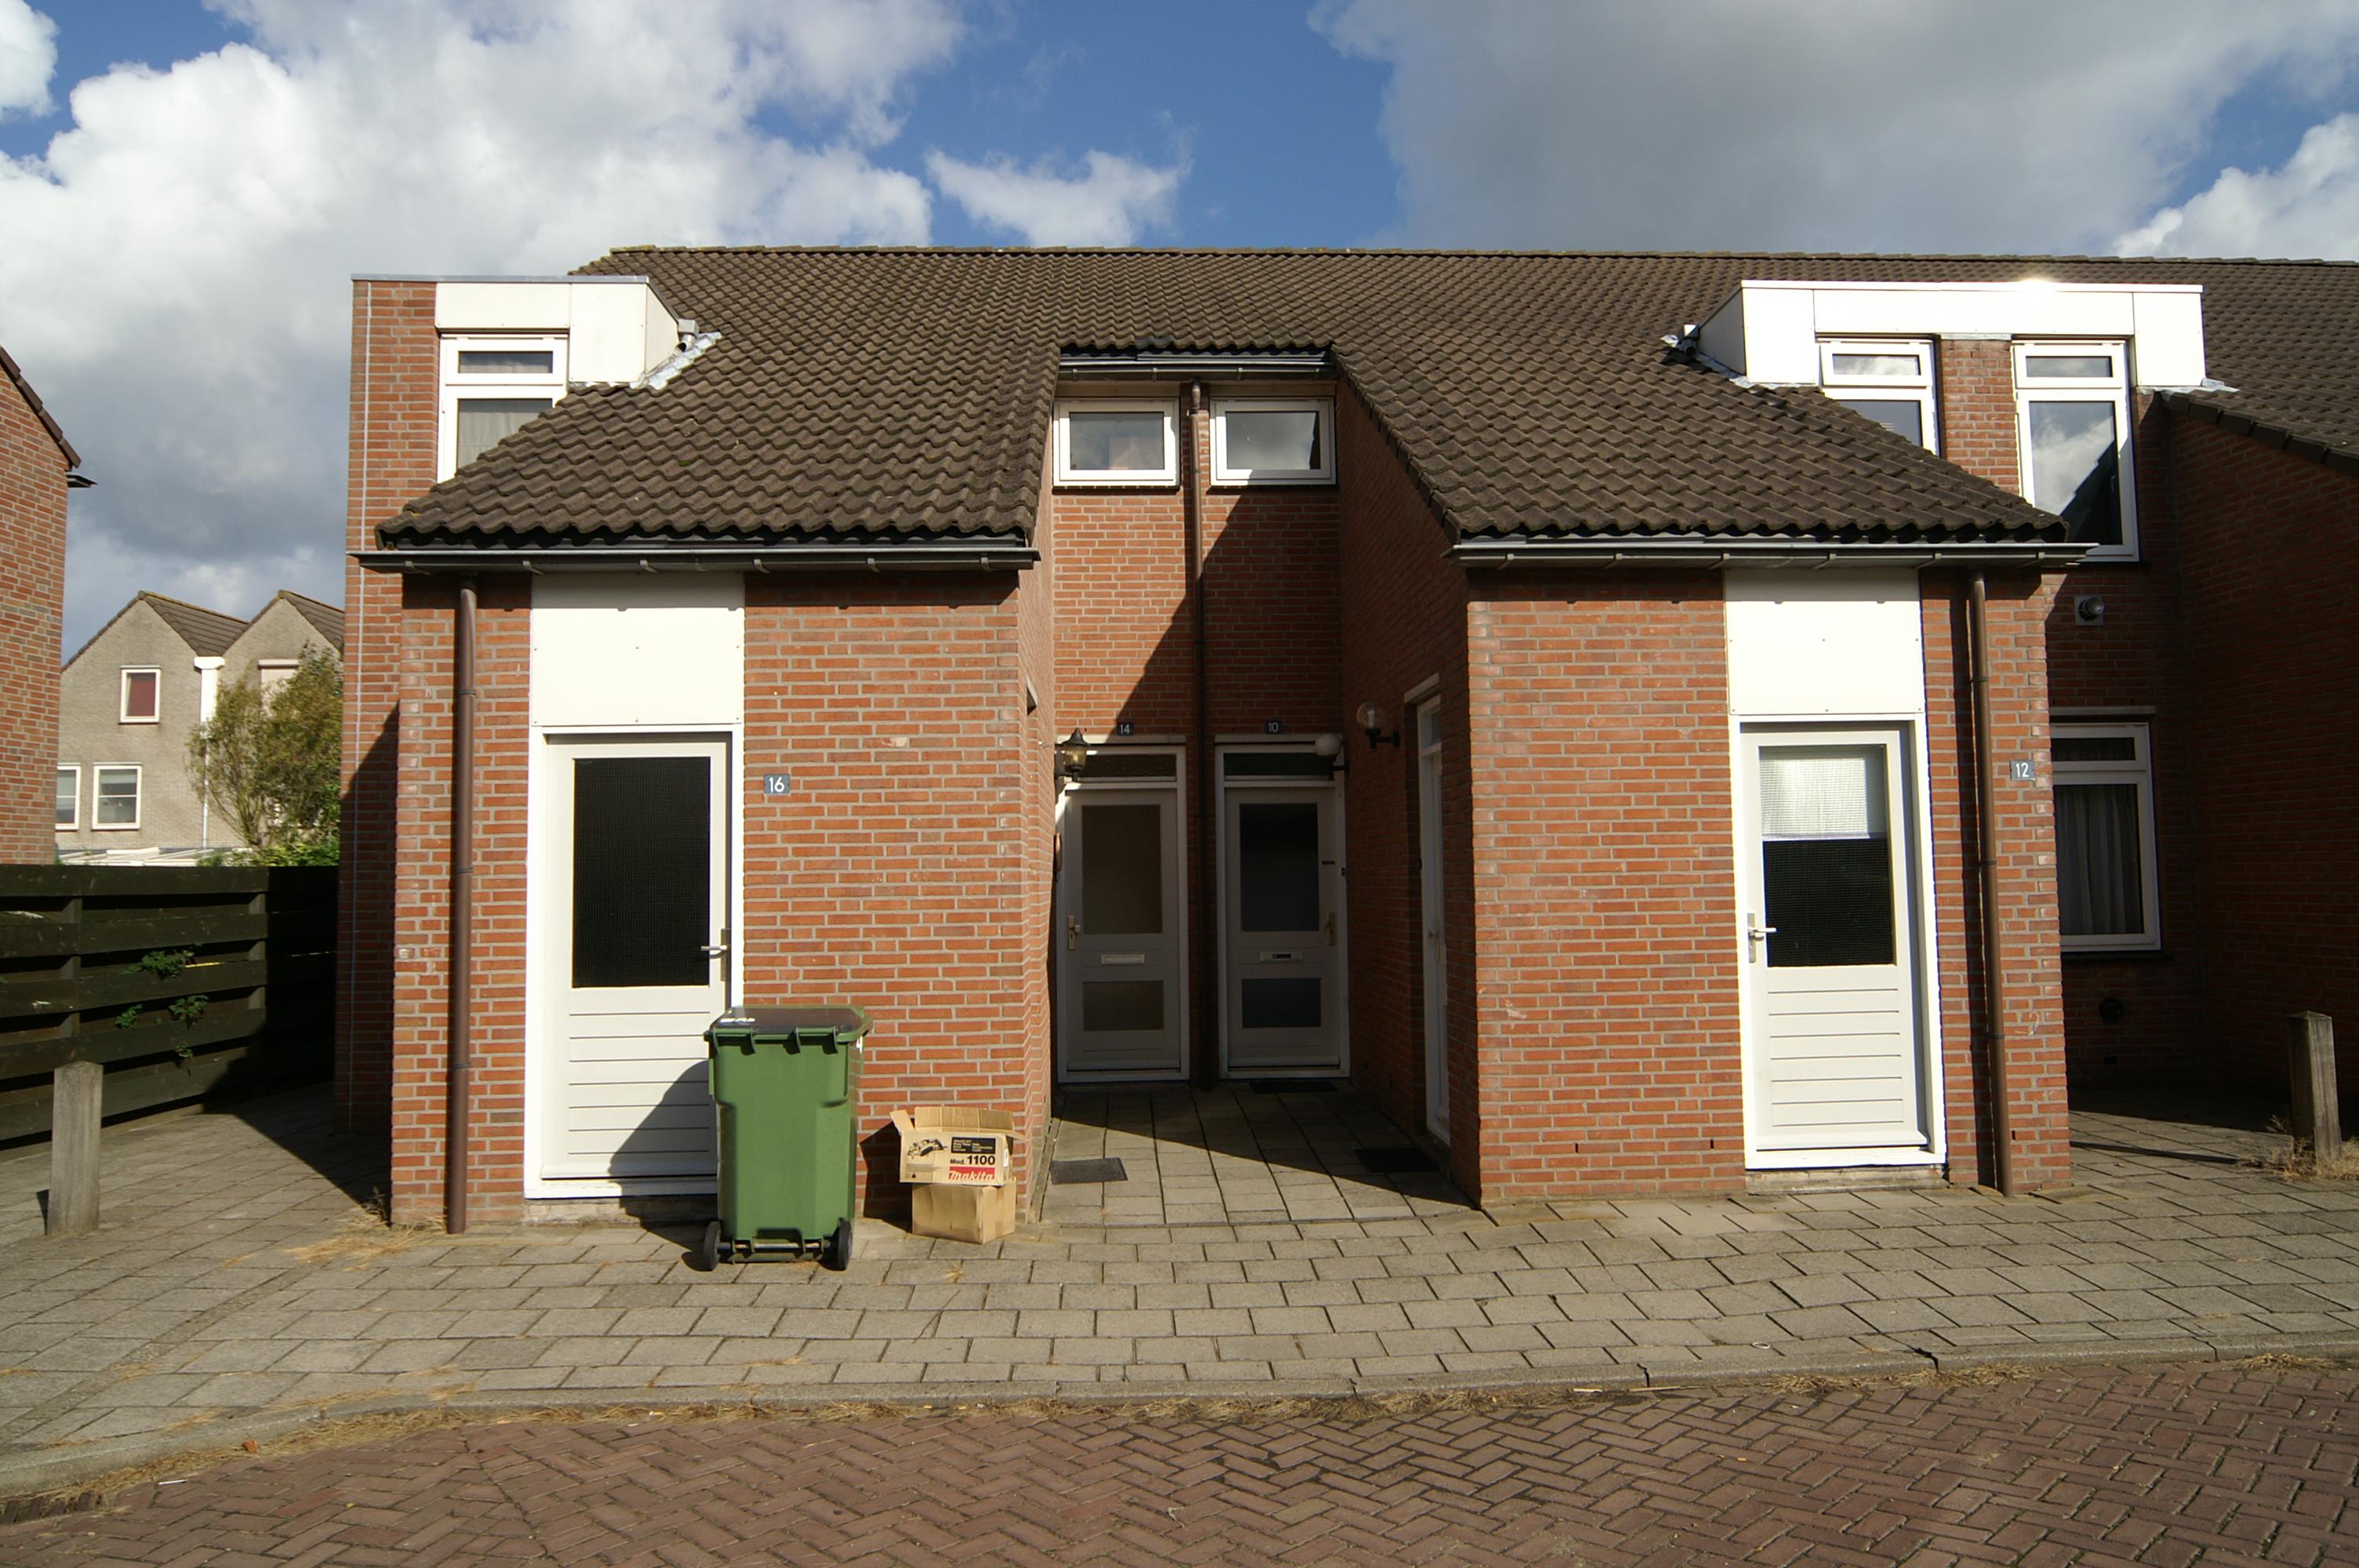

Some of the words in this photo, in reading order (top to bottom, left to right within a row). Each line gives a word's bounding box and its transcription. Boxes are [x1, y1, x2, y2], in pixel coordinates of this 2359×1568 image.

[1120, 724, 1130, 735] 14
[1268, 722, 1279, 733] 10
[2016, 762, 2030, 779] 12
[769, 776, 785, 793] 16
[967, 1155, 996, 1166] 1100
